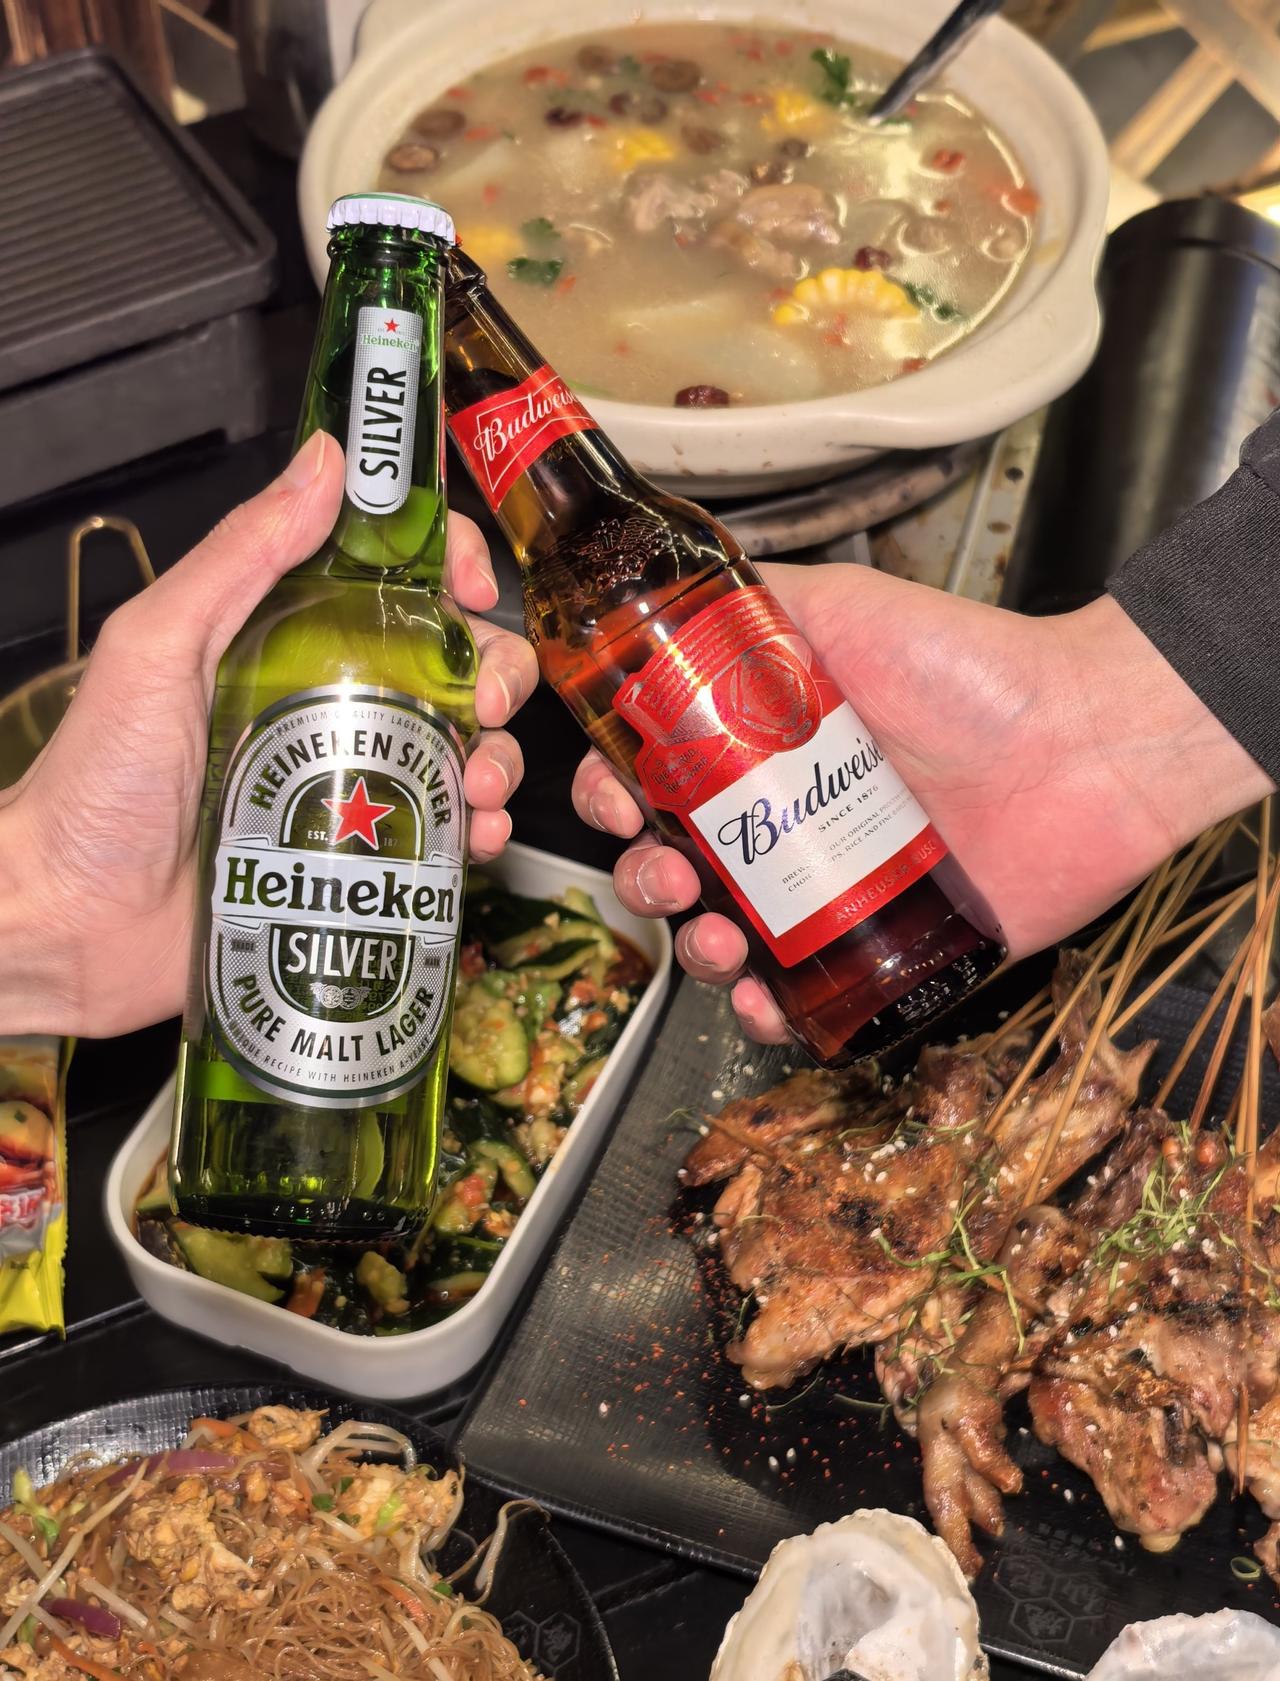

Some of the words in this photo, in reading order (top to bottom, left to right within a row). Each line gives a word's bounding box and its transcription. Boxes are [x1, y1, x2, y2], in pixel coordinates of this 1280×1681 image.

[363, 334, 416, 351] Heineken
[359, 366, 407, 480] SILVER
[474, 385, 578, 461] Budweis
[277, 711, 327, 735] PREMIUM
[334, 710, 385, 722] ALITY
[391, 715, 422, 734] LAGER
[250, 730, 393, 810] HEINEKEN
[397, 742, 450, 828] SILVER
[818, 803, 854, 833] SINCE
[856, 784, 879, 804] 1876
[829, 836, 847, 852] OUR
[847, 811, 879, 838] ORIGINAL
[864, 823, 879, 838] AND
[307, 830, 328, 841] EST.
[383, 836, 398, 847] 187
[223, 857, 453, 923] Heineken
[835, 865, 909, 921] ANHEUS
[286, 931, 398, 981] SILVER
[232, 974, 287, 1043] PURE
[290, 1028, 363, 1062] MALT
[375, 987, 435, 1057] LAGER
[264, 1054, 301, 1077] RECIPE
[308, 1070, 337, 1083] WITH
[343, 1065, 395, 1083] HEINEKEN
